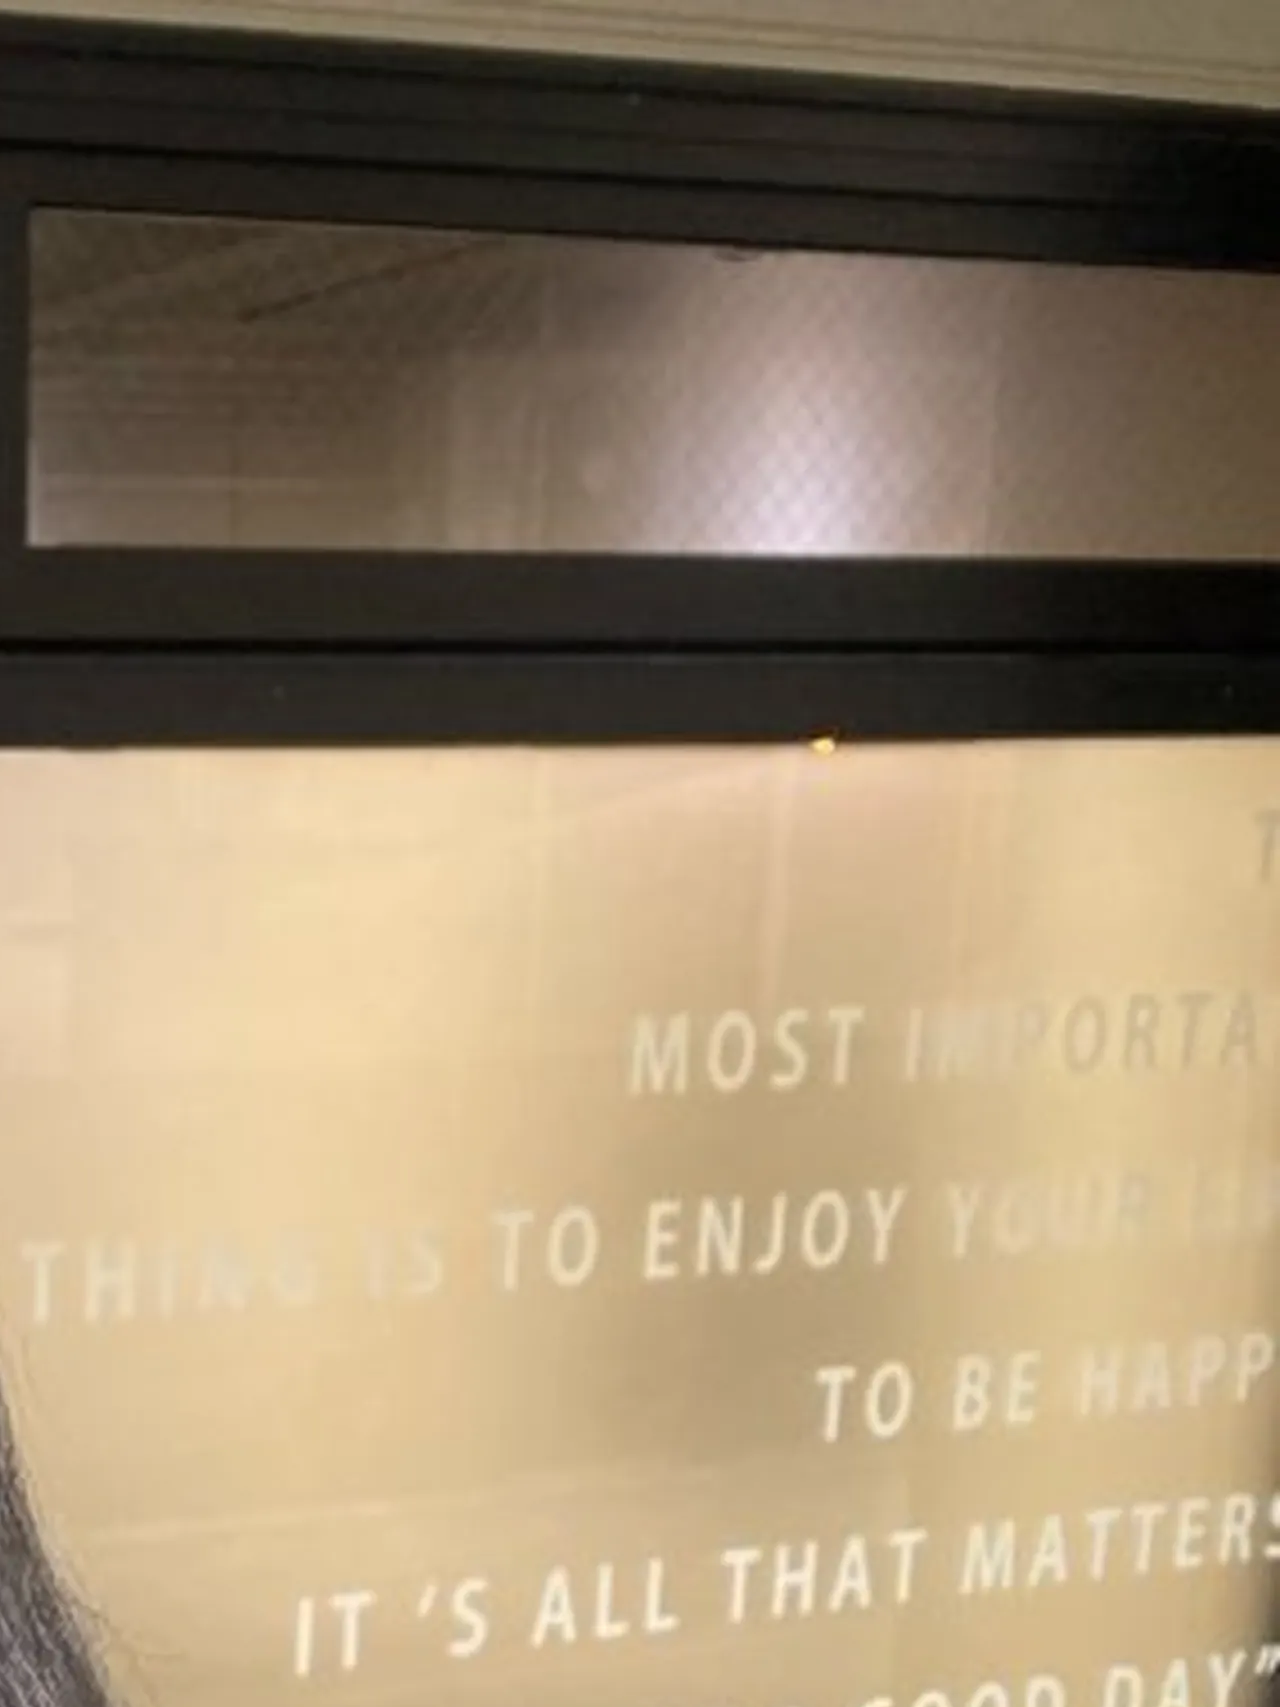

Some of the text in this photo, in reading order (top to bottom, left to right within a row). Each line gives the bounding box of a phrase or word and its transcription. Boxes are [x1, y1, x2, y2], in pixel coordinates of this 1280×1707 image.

[630, 1006, 865, 1096] MOST
[490, 1204, 600, 1293] TO
[643, 1187, 908, 1281] ENJOY
[815, 1361, 915, 1444] TO
[952, 1350, 1042, 1431] BE
[530, 1557, 680, 1650] ALL
[722, 1528, 928, 1622] THAT
